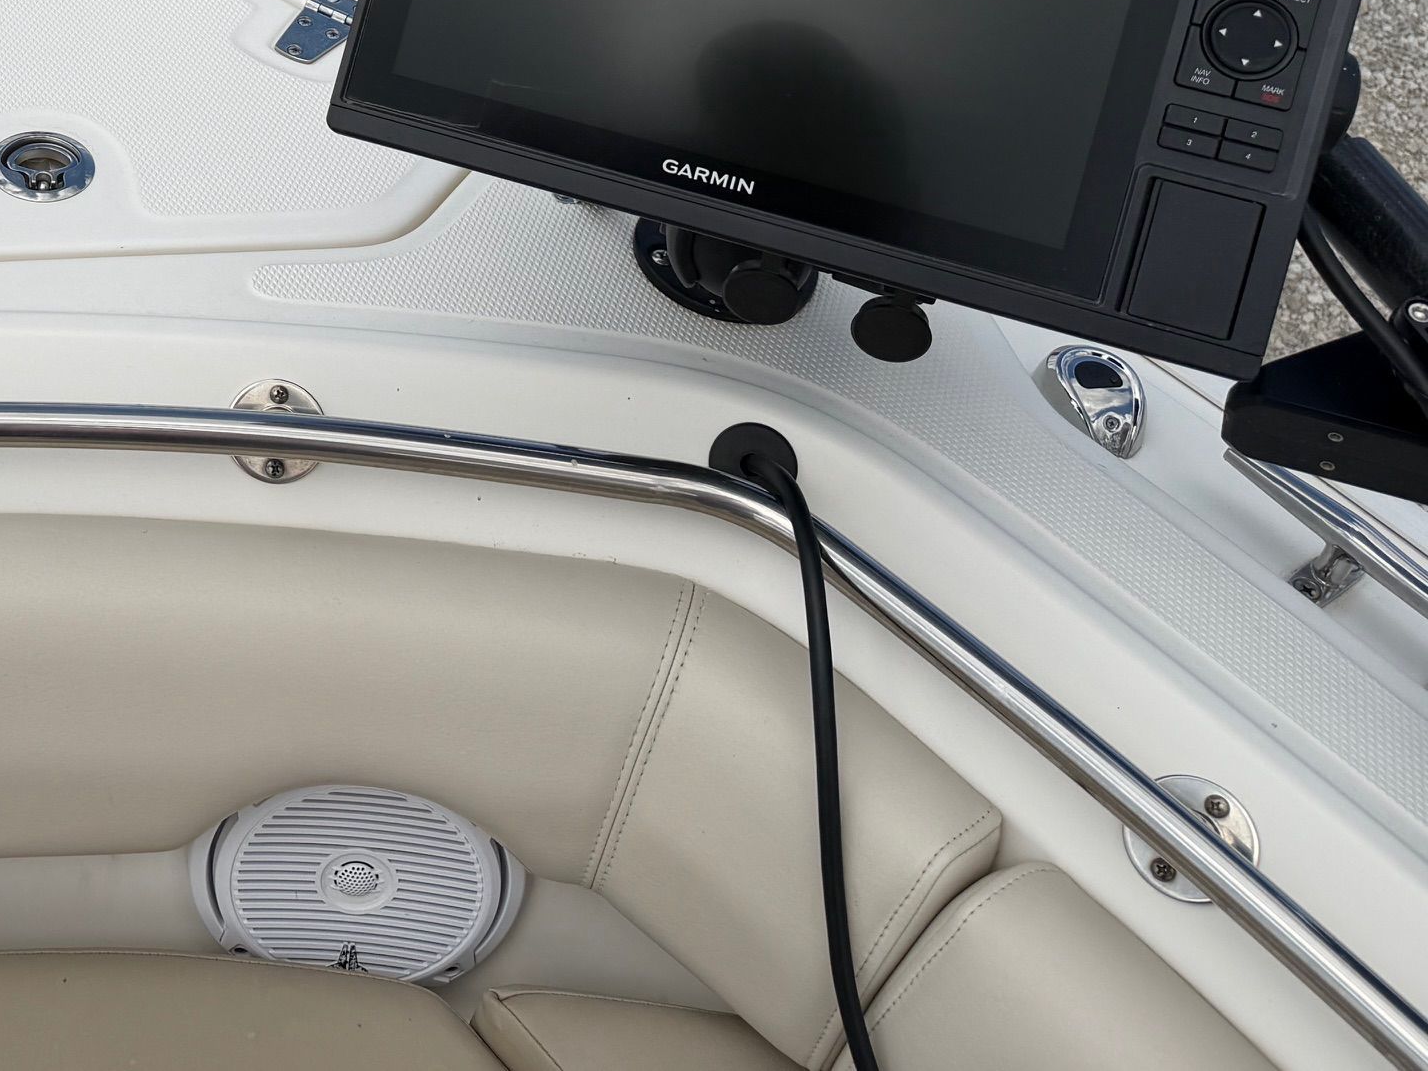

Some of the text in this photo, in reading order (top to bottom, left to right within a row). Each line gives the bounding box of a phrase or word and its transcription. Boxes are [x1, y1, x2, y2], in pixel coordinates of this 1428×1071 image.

[1194, 67, 1212, 78] NAV
[1190, 75, 1210, 85] INFO
[1261, 84, 1285, 96] MARK
[1250, 131, 1258, 139] 2
[662, 158, 755, 195] GARMIN
